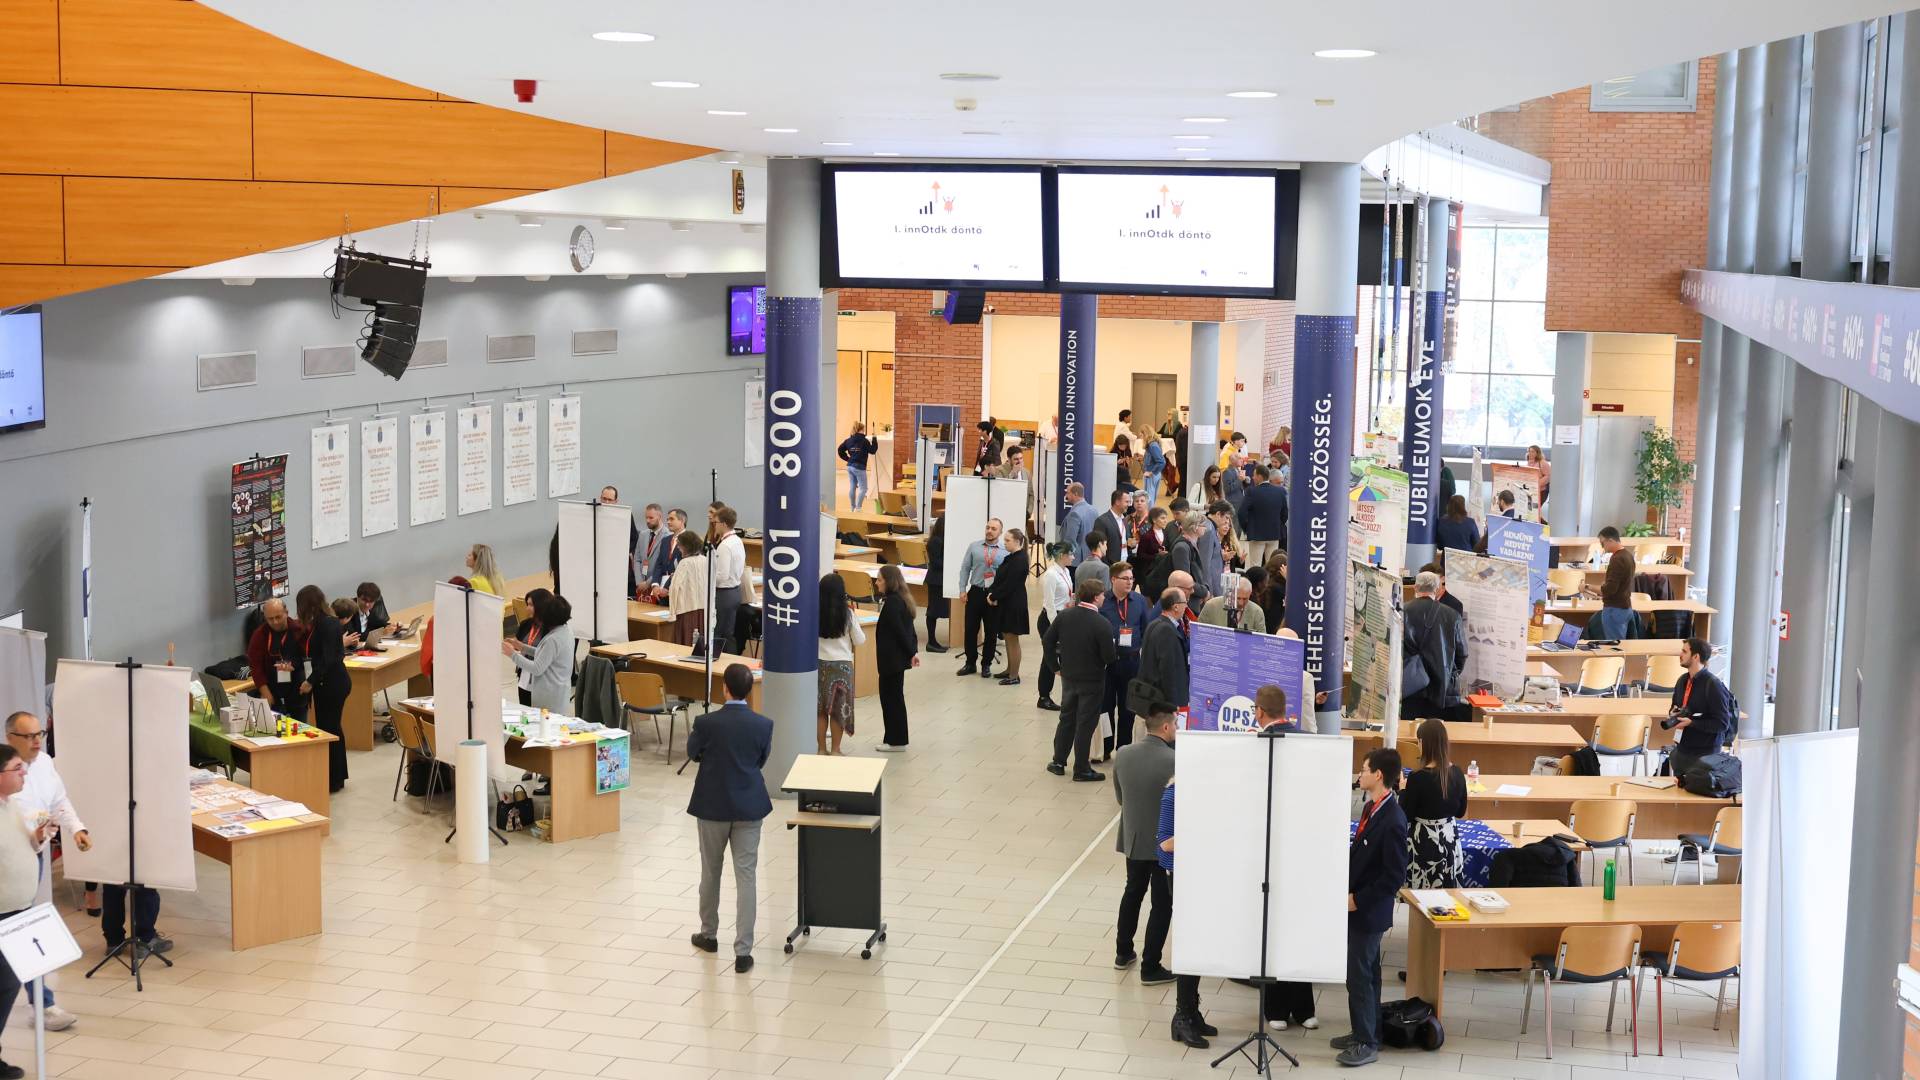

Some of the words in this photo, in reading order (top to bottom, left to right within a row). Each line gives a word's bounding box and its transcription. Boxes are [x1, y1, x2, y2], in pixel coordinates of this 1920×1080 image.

[904, 225, 947, 234] innOtdk
[1129, 228, 1174, 239] innOtdk
[1066, 329, 1078, 409] INNOVATION
[769, 389, 802, 478] 800
[1065, 412, 1075, 440] AND
[1308, 393, 1332, 504] KÖZÖSSÉG.
[1410, 388, 1433, 527] JUBILEUMOK
[780, 495, 787, 510] -
[1063, 443, 1074, 510] TRDITION
[1309, 511, 1328, 574] SIKER.
[767, 528, 801, 627] #601
